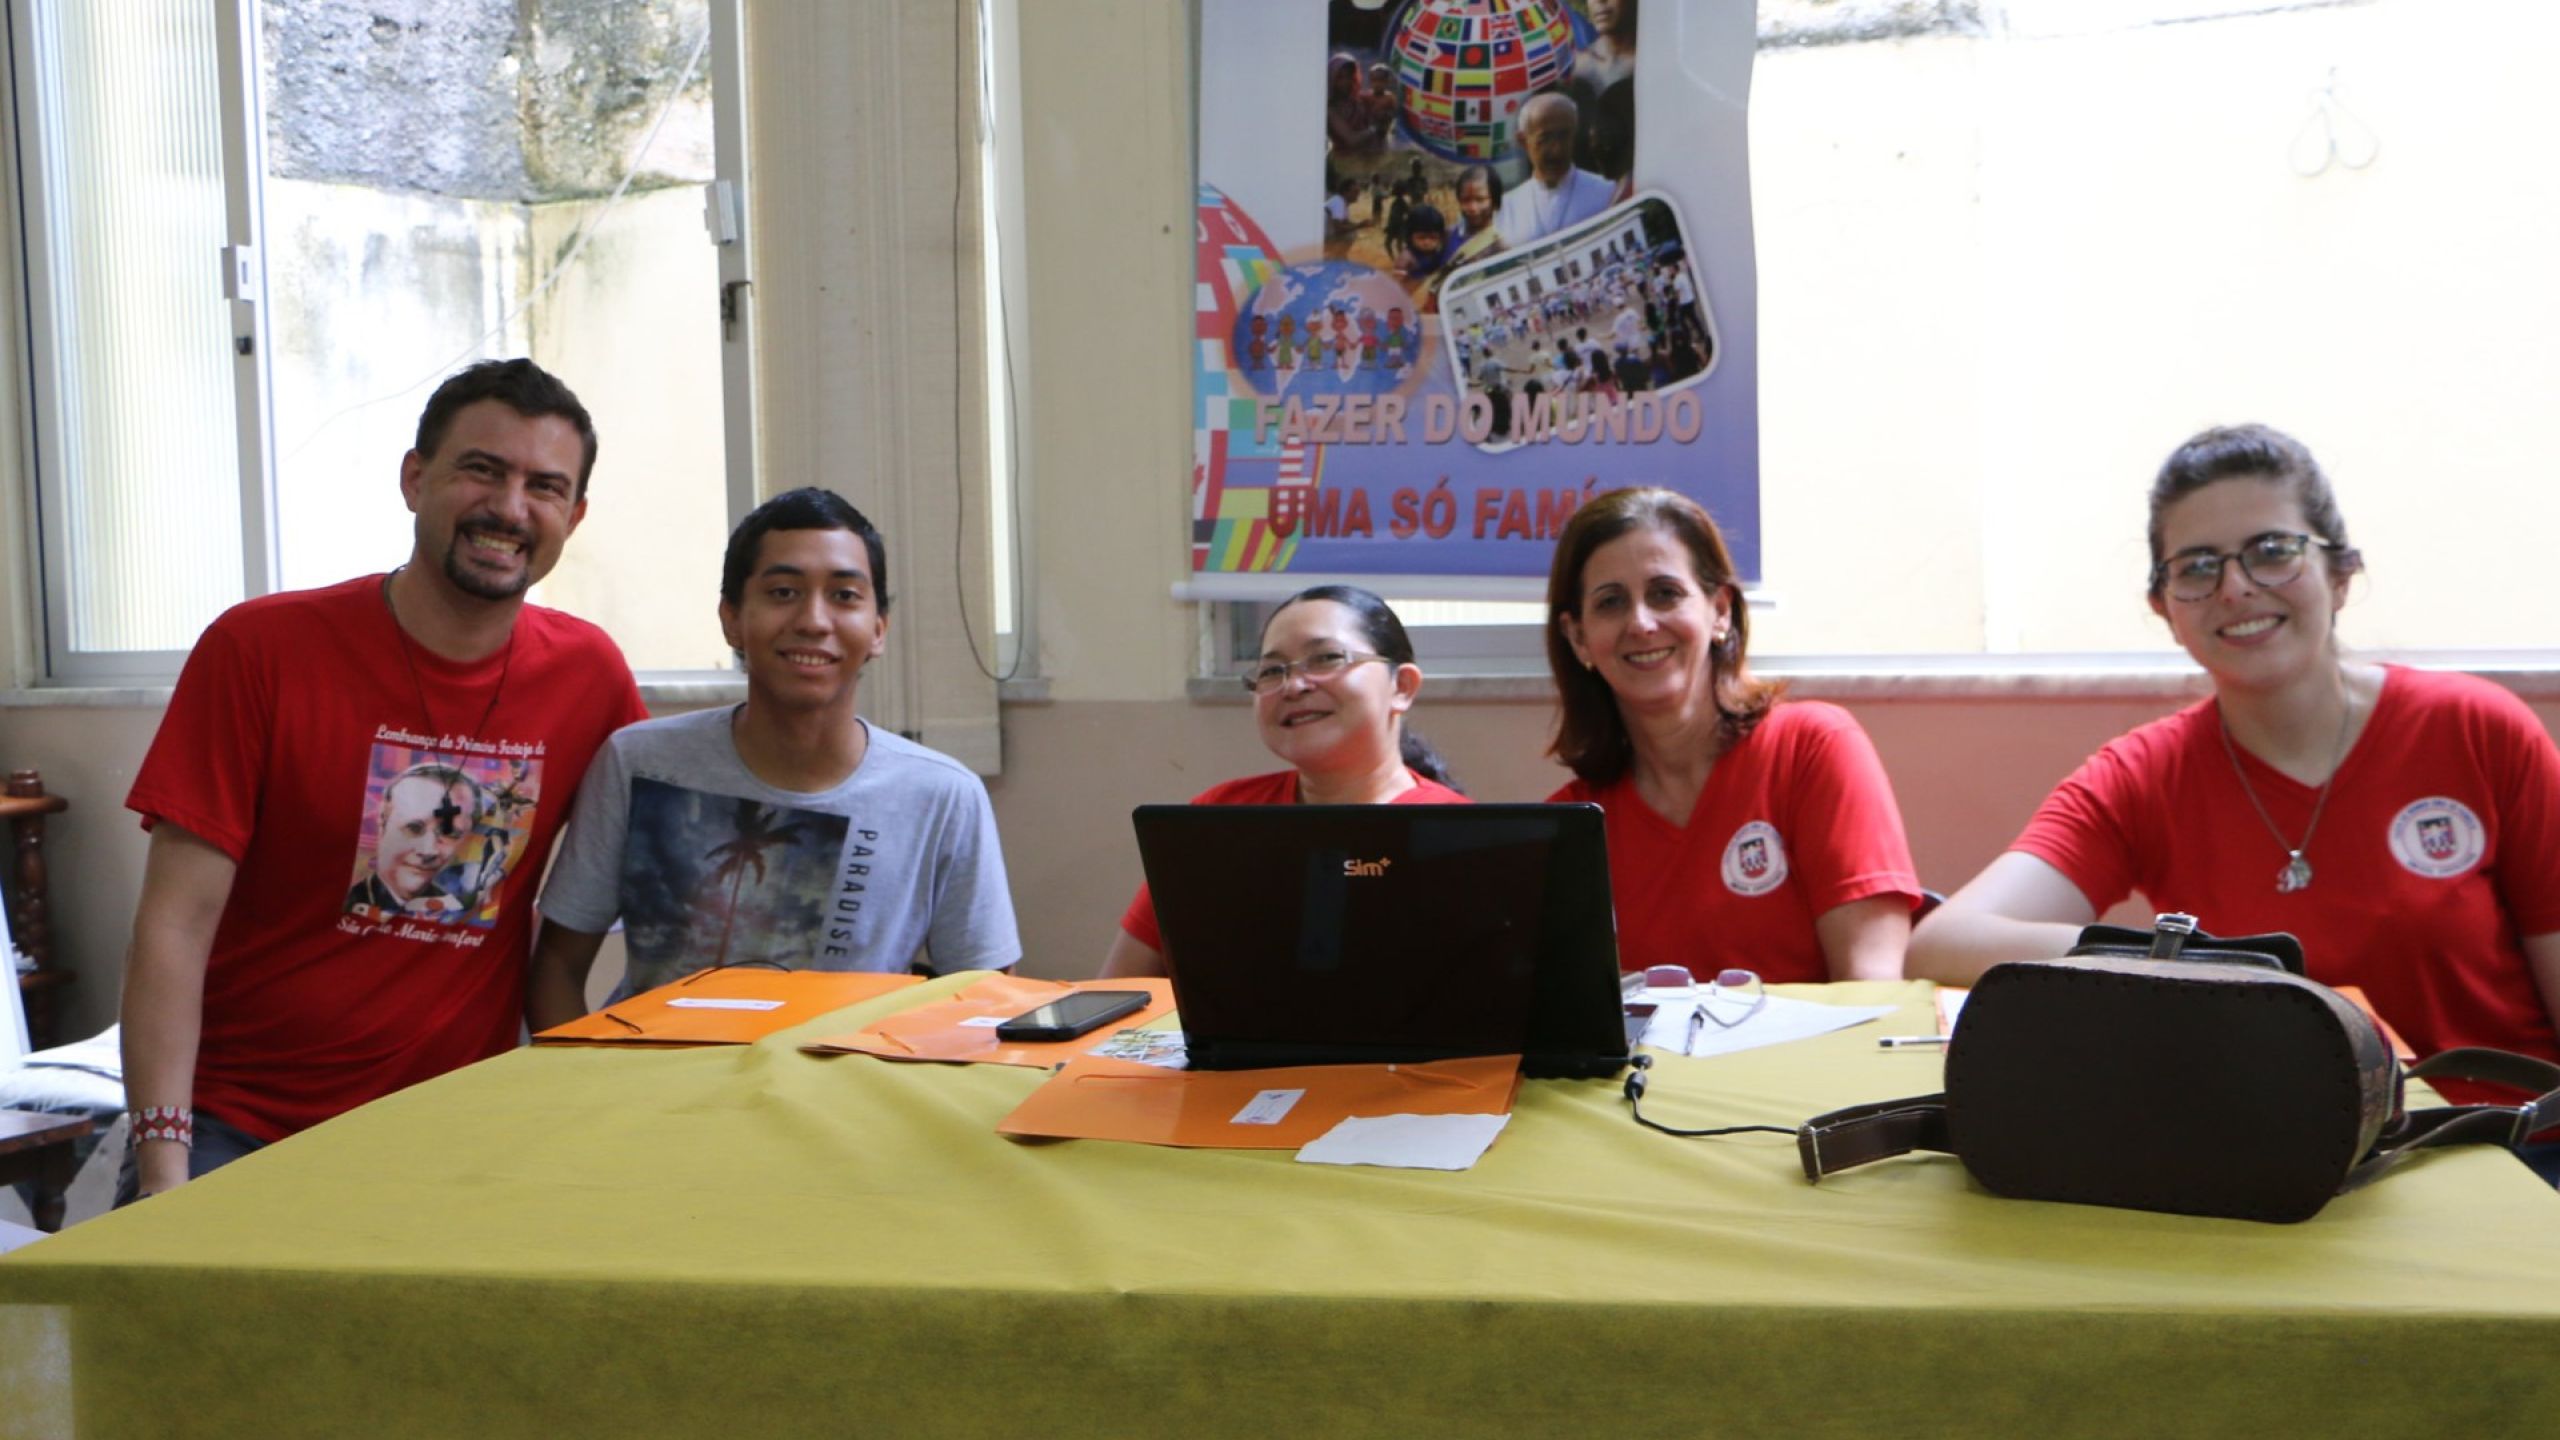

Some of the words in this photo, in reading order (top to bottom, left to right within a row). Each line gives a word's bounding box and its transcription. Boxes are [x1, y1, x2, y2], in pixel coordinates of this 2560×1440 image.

[1256, 393, 1409, 445] FAZER
[1424, 393, 1494, 445] DO
[1511, 390, 1704, 445] MUNDO
[1268, 486, 1374, 539] UMA
[1389, 475, 1458, 540] SÓ
[824, 828, 879, 957] PARADISE
